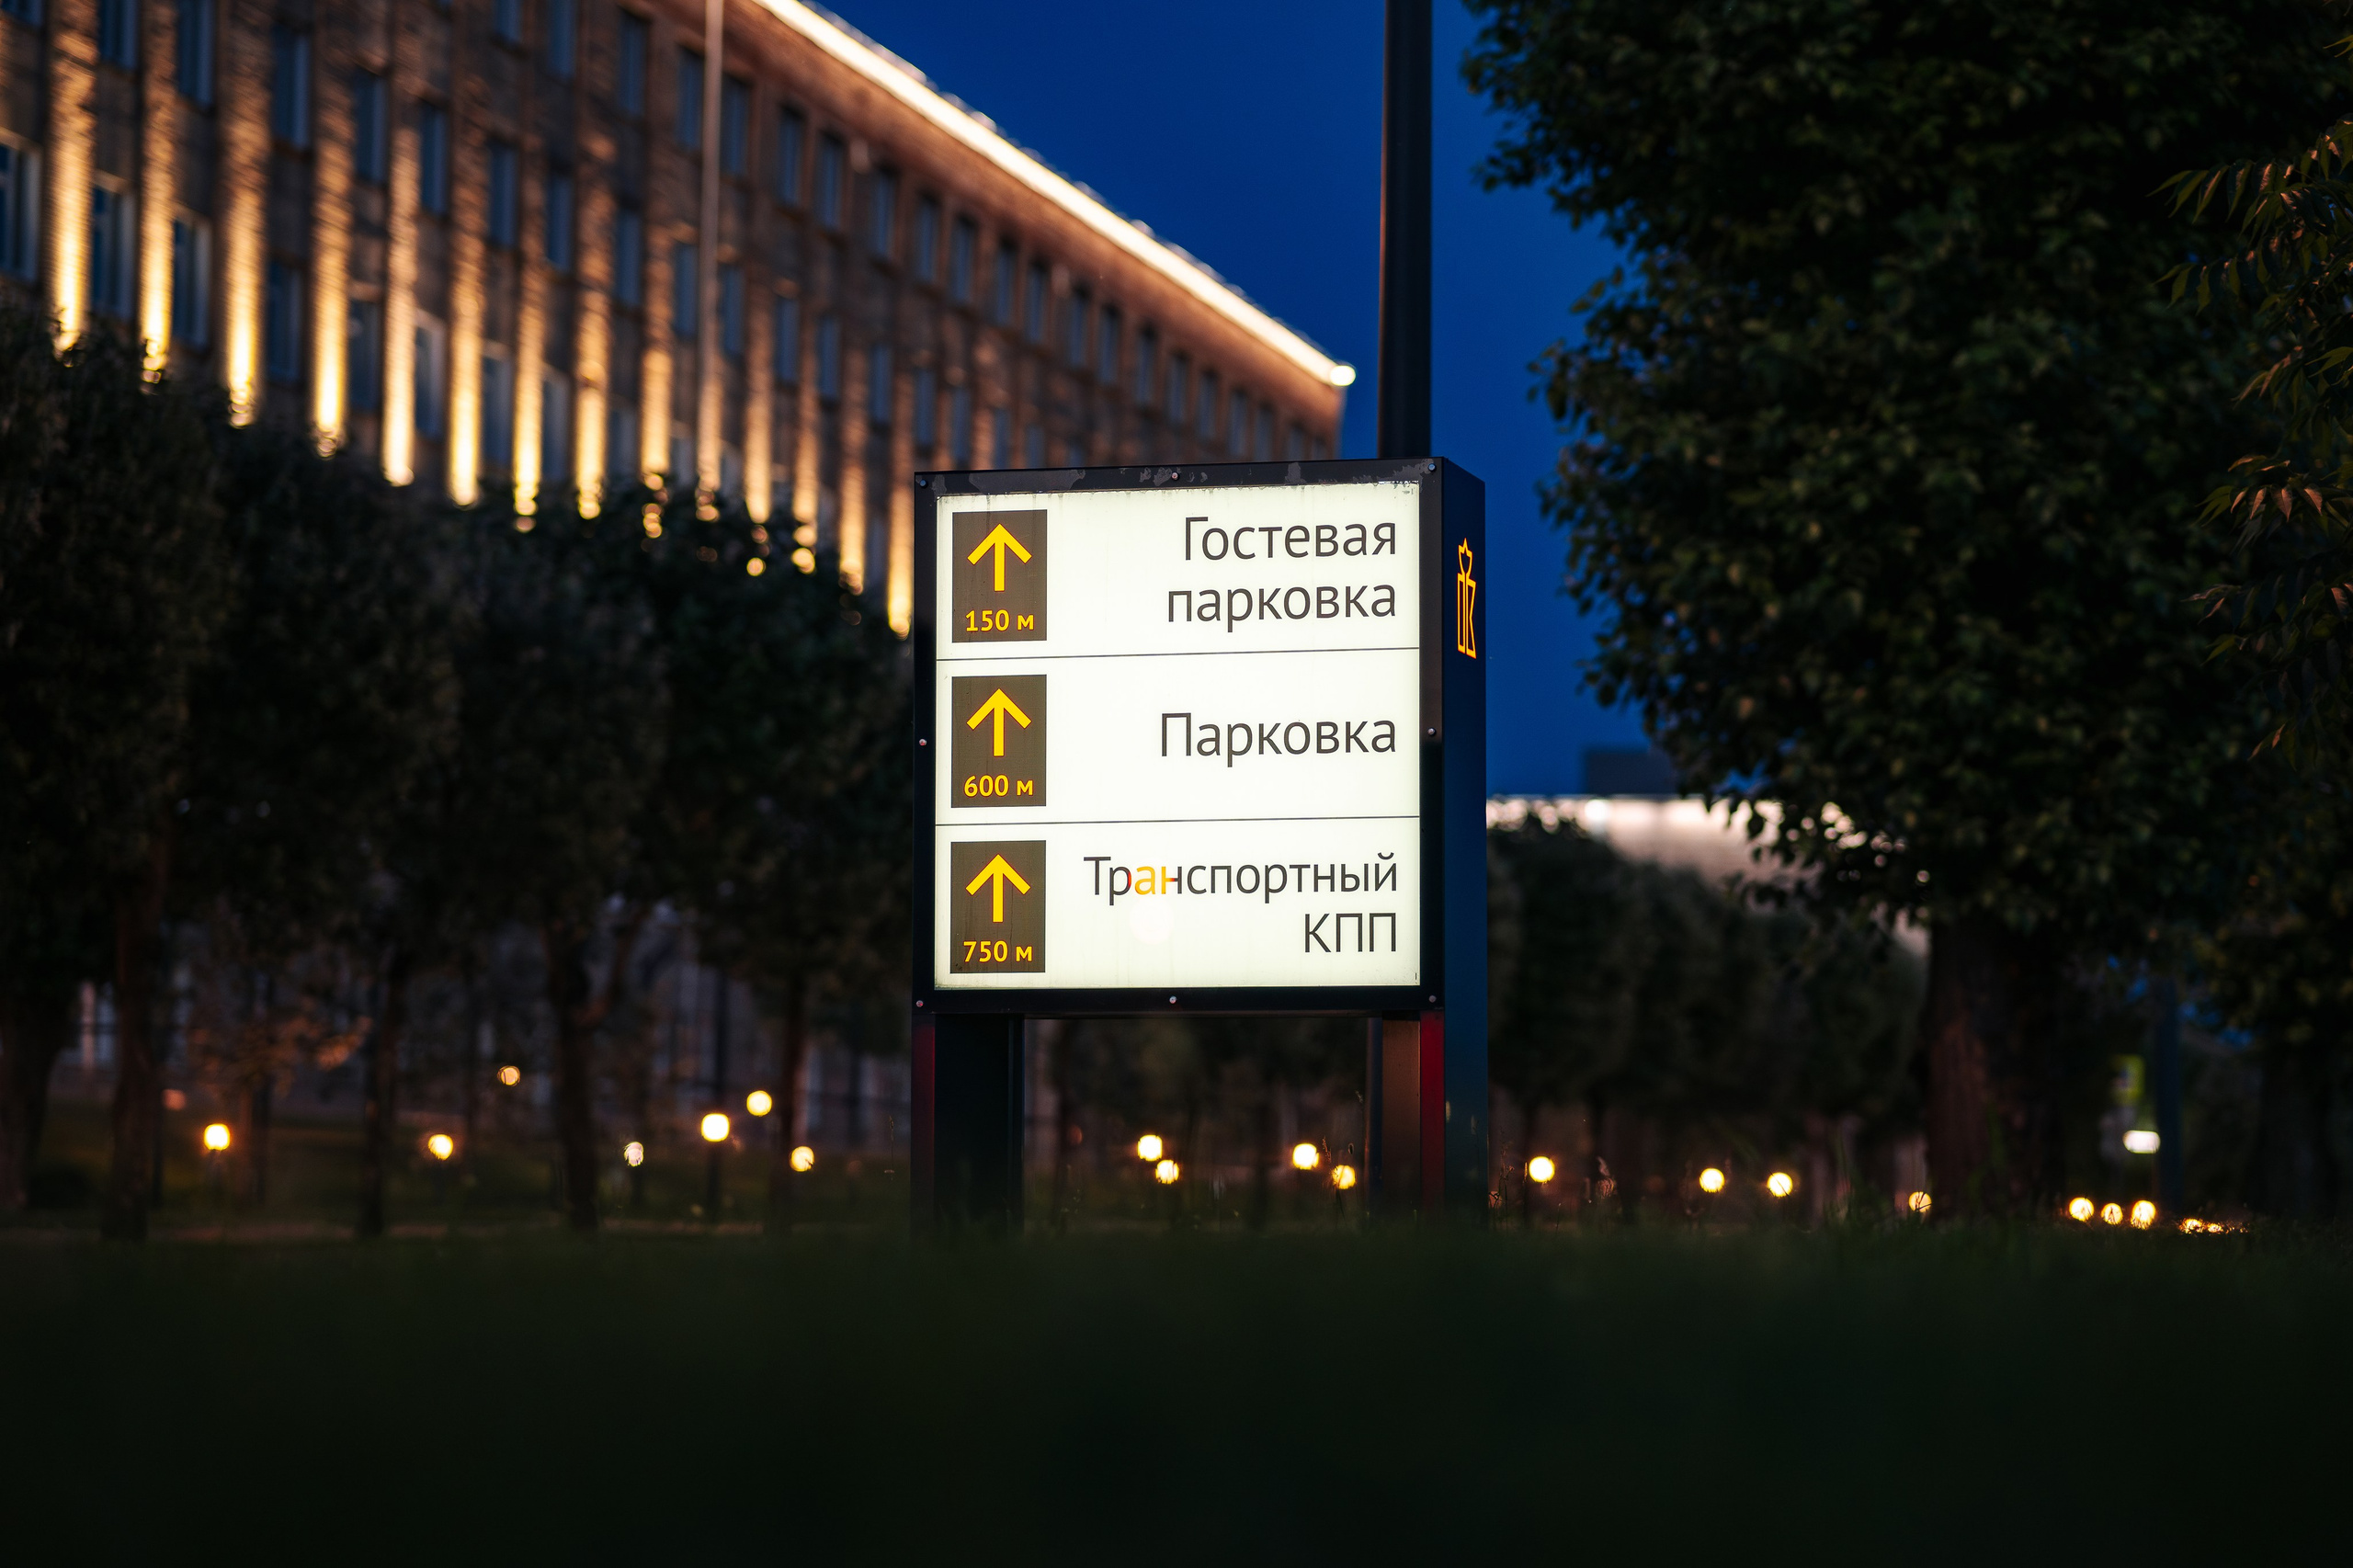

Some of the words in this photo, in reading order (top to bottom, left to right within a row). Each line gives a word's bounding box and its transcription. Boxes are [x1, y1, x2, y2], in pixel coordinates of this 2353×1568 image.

[1186, 517, 1395, 560] Гостевая
[966, 609, 1009, 631] 150
[1017, 615, 1033, 630] м
[1169, 585, 1395, 632] парковка
[1162, 713, 1395, 767] Парковка
[964, 775, 1008, 797] 600
[1017, 780, 1033, 795] м
[1084, 853, 1396, 905] Транспортный
[964, 941, 1007, 962] 750
[1017, 947, 1032, 961] м
[1305, 913, 1396, 952] КПП
